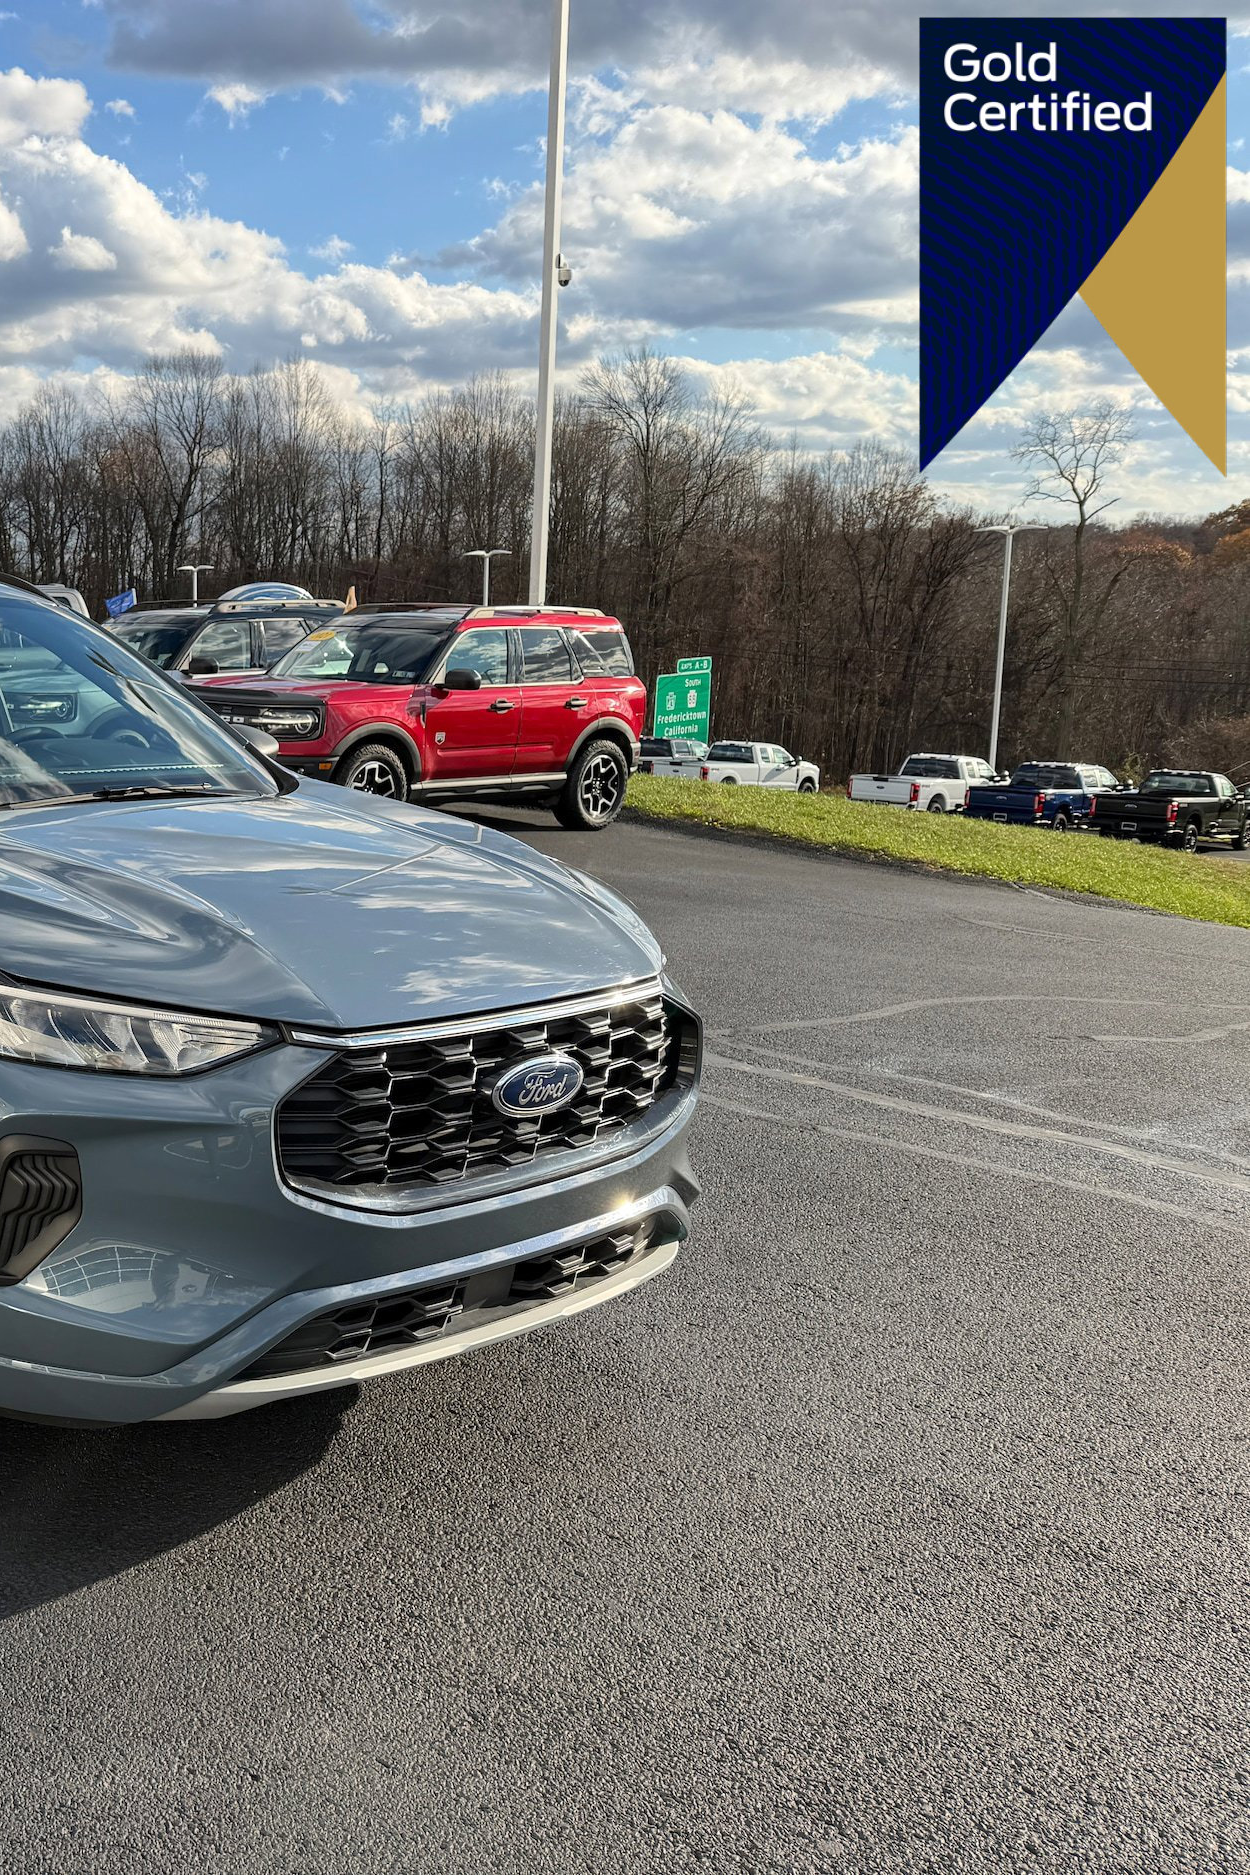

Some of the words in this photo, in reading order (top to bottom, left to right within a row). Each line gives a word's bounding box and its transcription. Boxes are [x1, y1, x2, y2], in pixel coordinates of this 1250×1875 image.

[657, 711, 707, 725] Fredericktown
[664, 724, 699, 737] California
[518, 1069, 568, 1105] Ford
